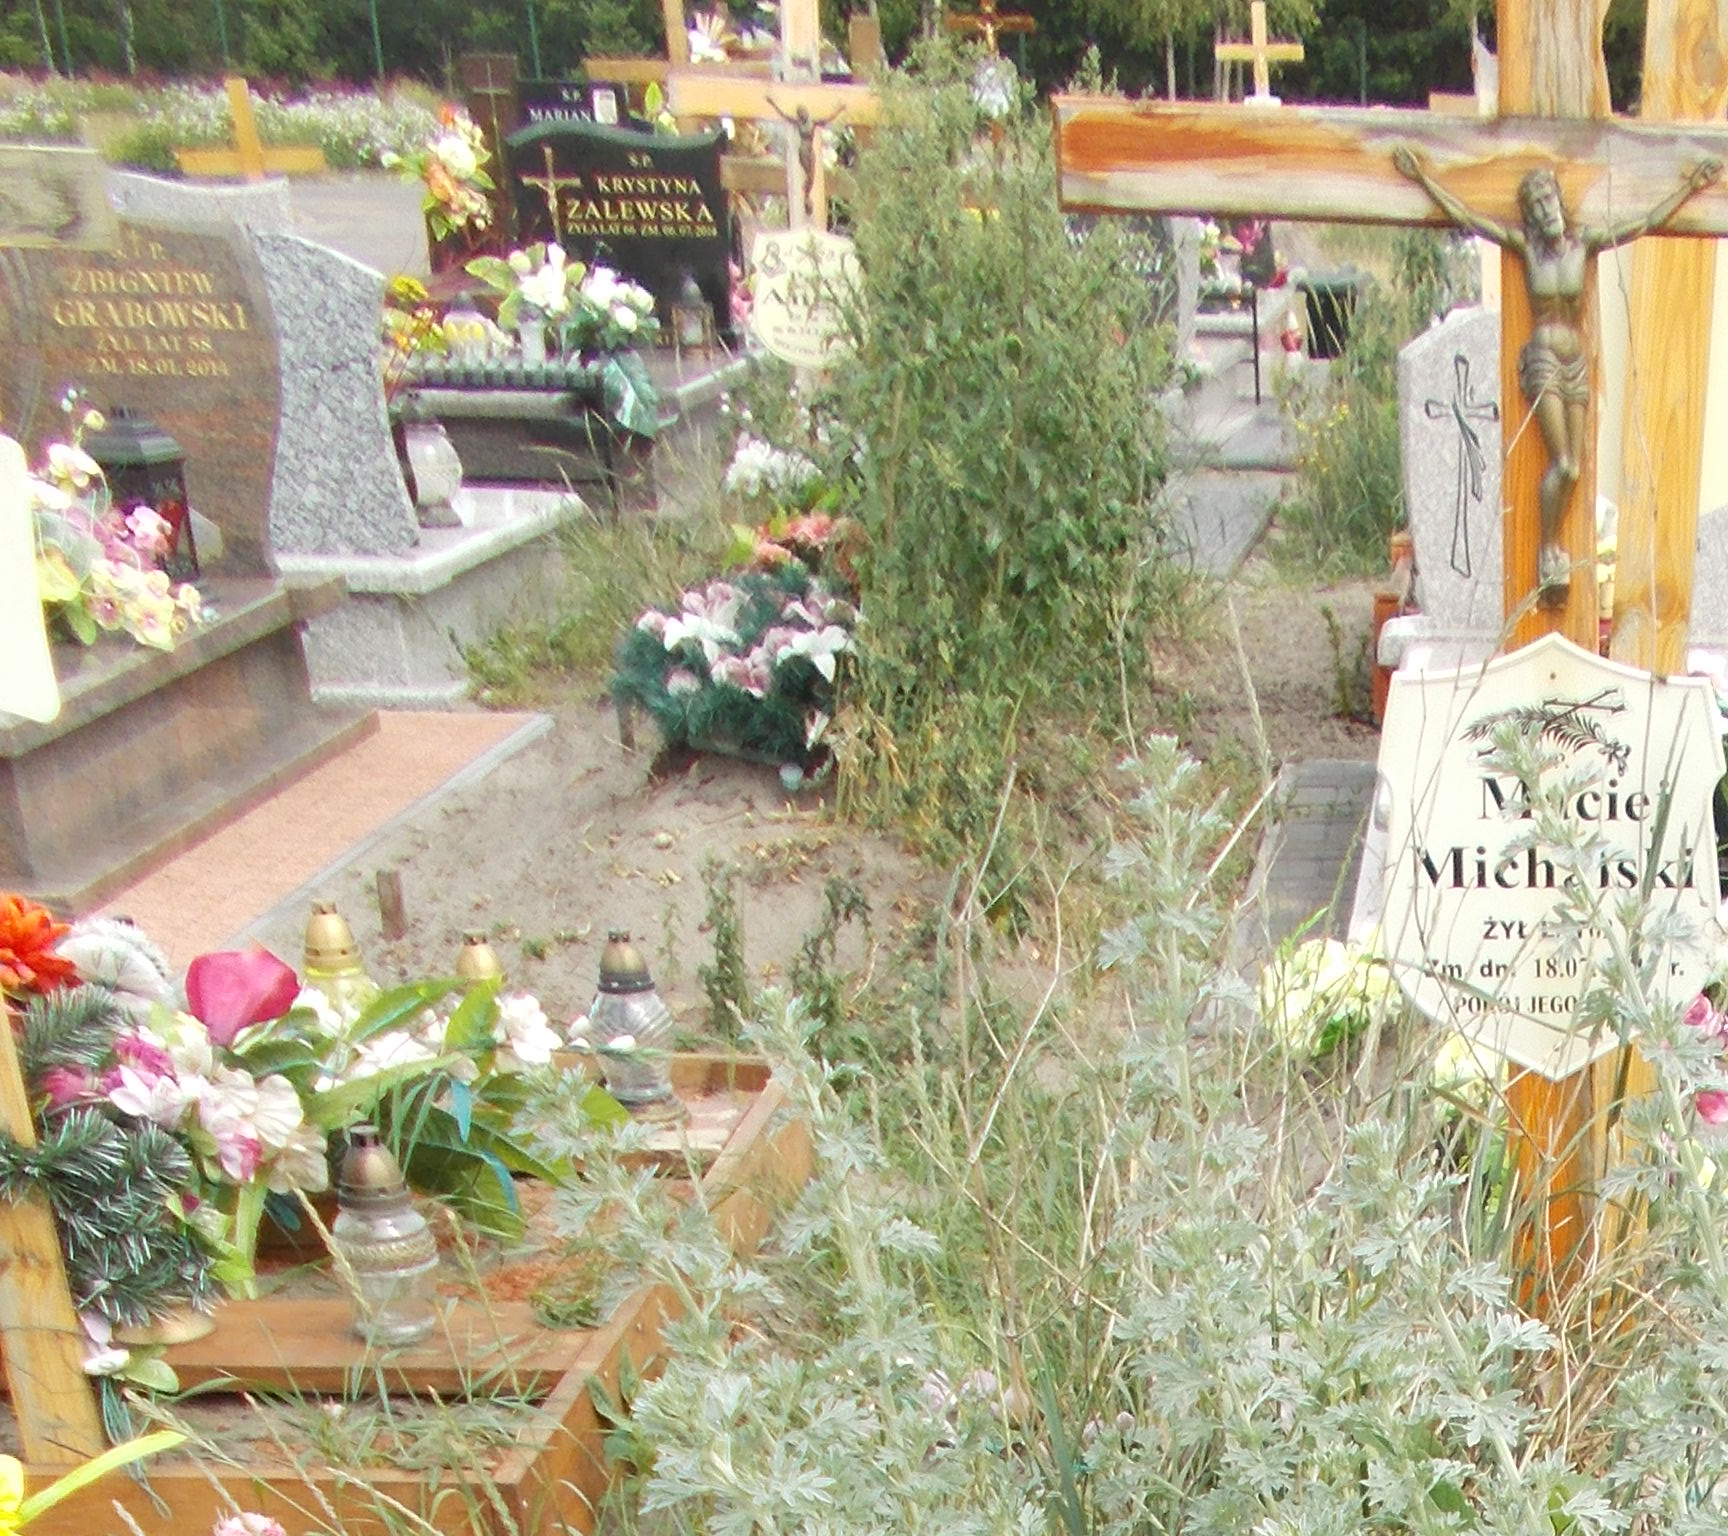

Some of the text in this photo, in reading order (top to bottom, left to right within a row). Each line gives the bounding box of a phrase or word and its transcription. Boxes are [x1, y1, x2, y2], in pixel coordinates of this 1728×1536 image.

[529, 107, 593, 123] MARIAN
[596, 175, 702, 195] KRYSTYNA
[69, 270, 213, 294] ZBIGNIEW
[53, 300, 249, 330] GRABOWSKI
